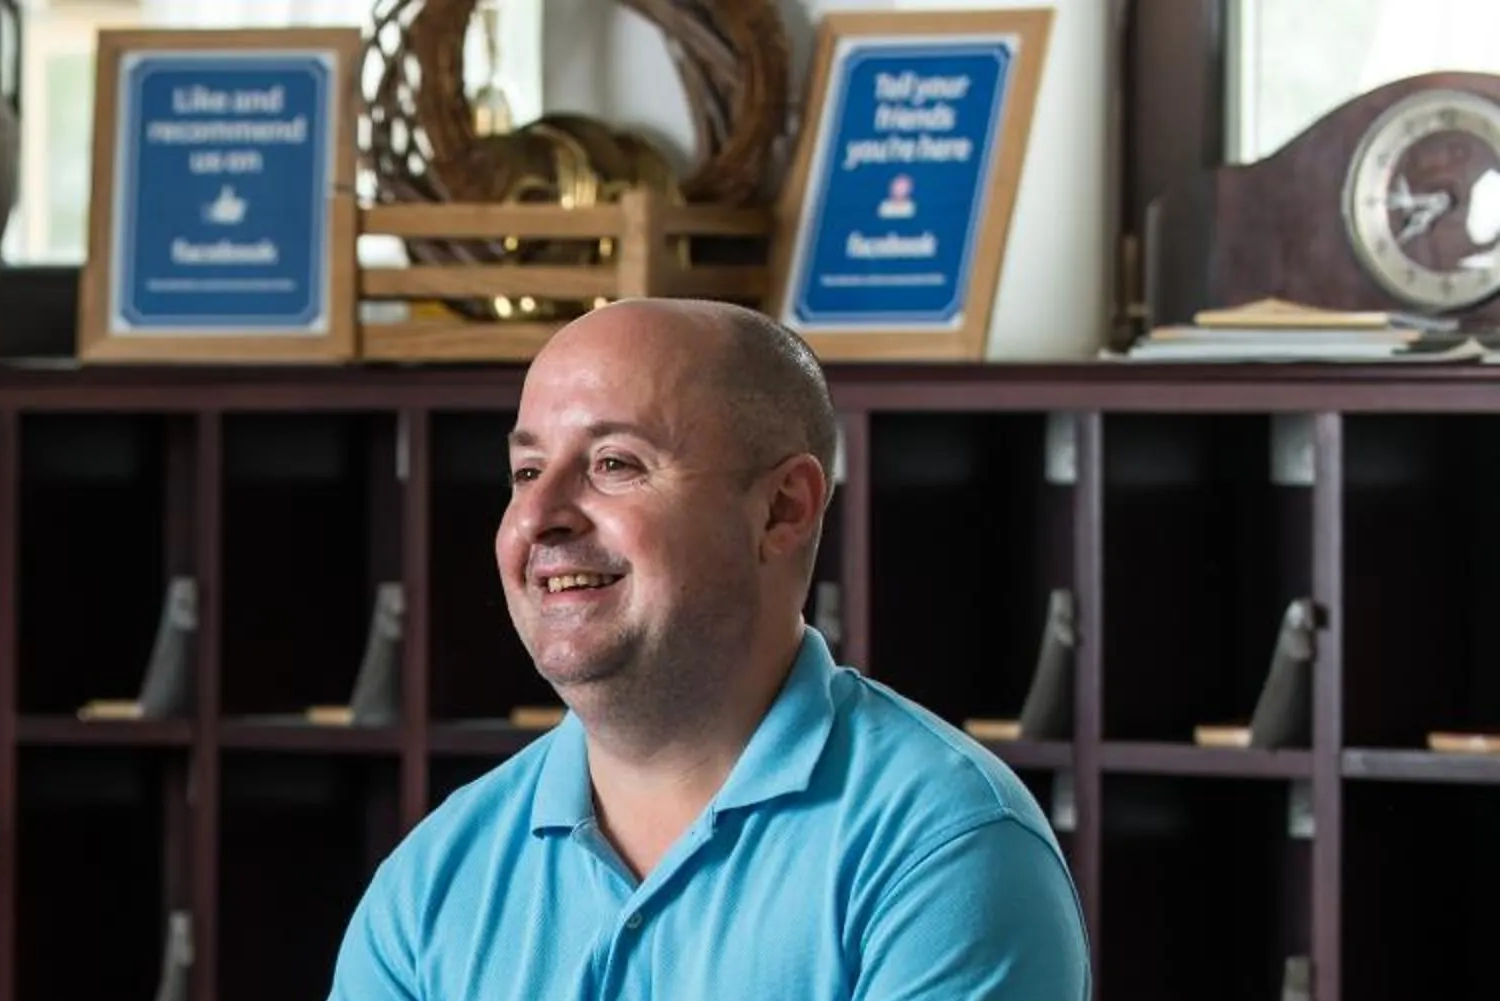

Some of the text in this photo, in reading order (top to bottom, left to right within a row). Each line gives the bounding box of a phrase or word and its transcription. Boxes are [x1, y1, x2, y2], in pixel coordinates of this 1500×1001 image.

[172, 86, 285, 113] Like and
[874, 71, 970, 105] Tell your
[148, 116, 306, 142] recommend
[874, 103, 955, 130] friends
[917, 135, 972, 161] here
[189, 152, 263, 174] us on
[170, 238, 278, 263] facebook
[846, 231, 937, 257] facebook
